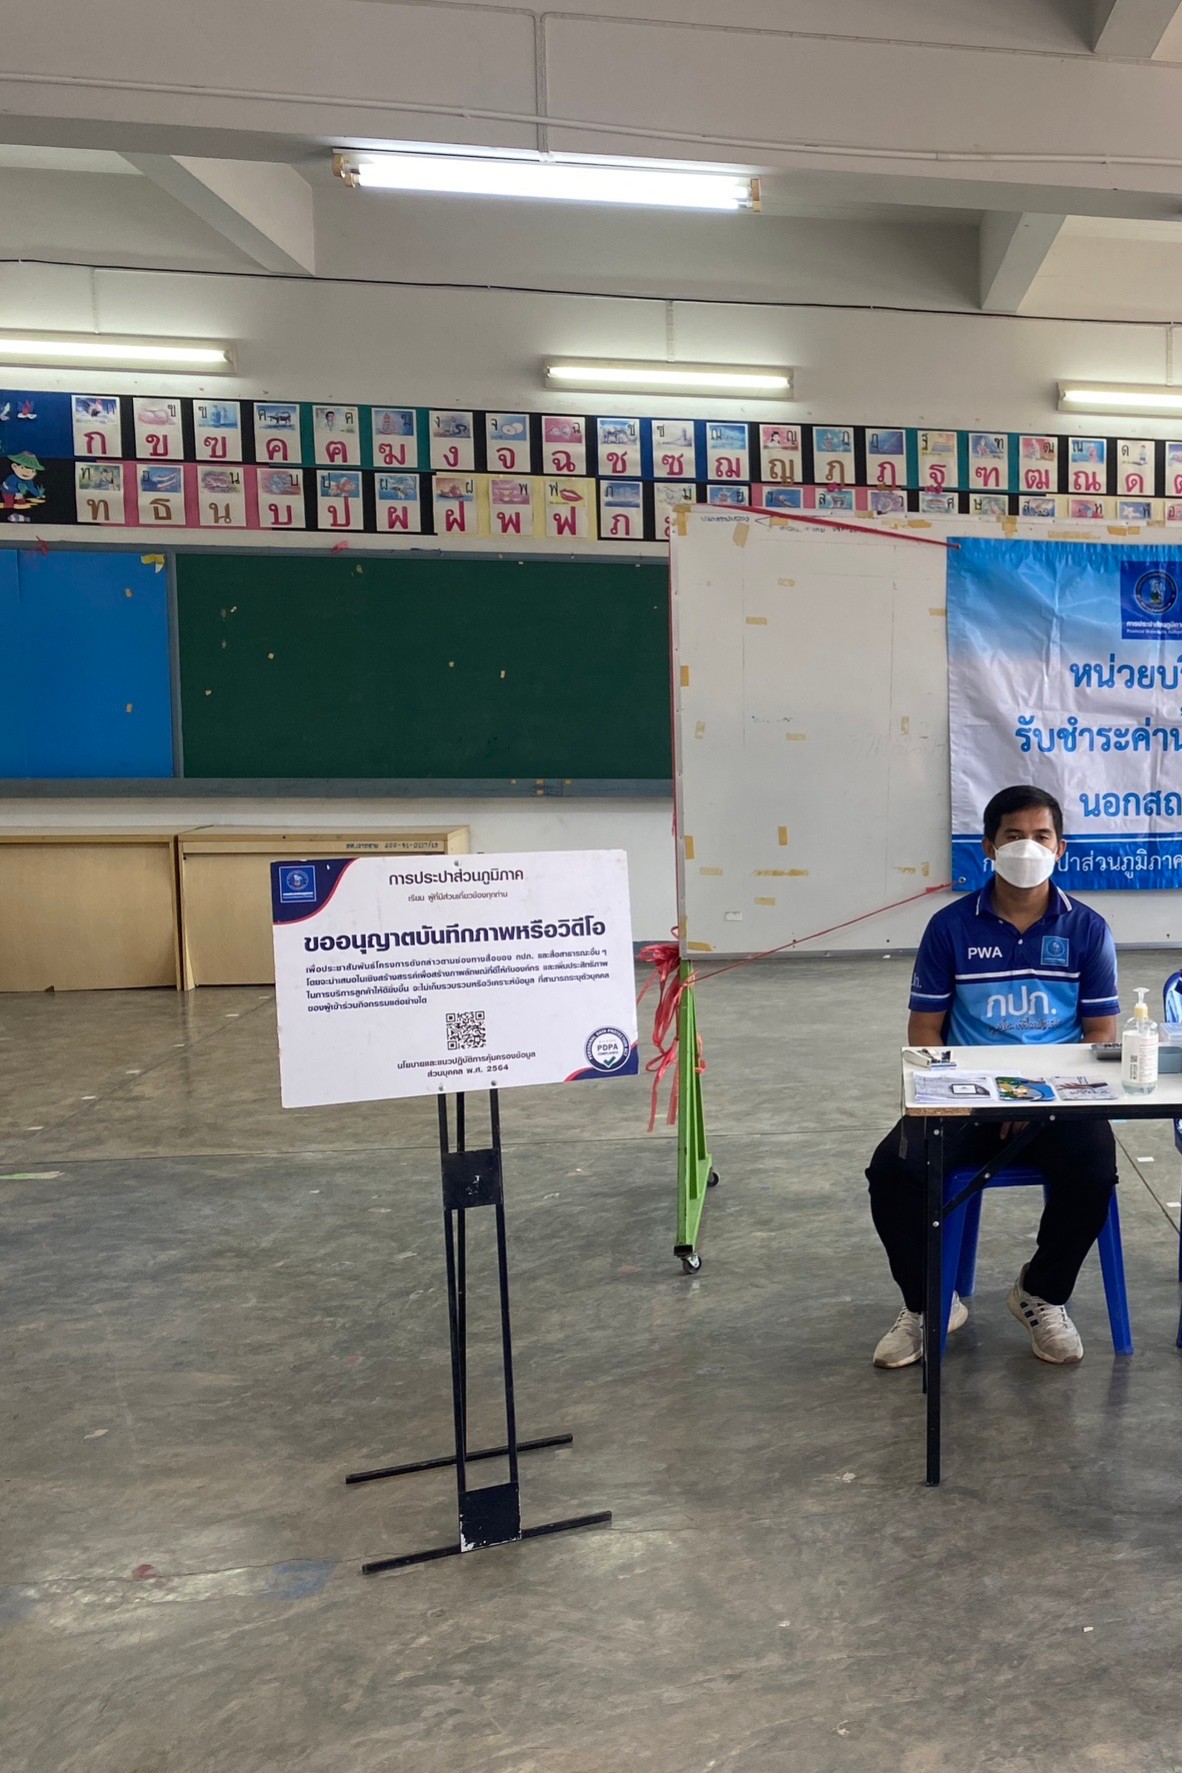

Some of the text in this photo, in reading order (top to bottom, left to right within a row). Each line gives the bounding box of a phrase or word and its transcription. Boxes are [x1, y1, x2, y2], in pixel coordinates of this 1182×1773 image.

[83, 431, 107, 454] ก
[145, 434, 168, 457] ข
[204, 436, 226, 458] ฃ
[266, 438, 288, 461] ค
[325, 441, 348, 463] ฅ
[379, 443, 405, 465] ฆ
[443, 446, 458, 467] ง
[496, 447, 515, 469] จ
[552, 450, 576, 472] ฉ
[607, 451, 628, 474] ช
[662, 453, 684, 476] ซ
[715, 457, 741, 478] ฌ
[768, 458, 794, 487] ญ
[925, 464, 947, 494] ฐ
[975, 466, 1000, 487] ฑ
[1025, 469, 1050, 490] ฒ
[1073, 470, 1101, 491] ณ
[1125, 473, 1144, 493] ด
[87, 496, 630, 536] ท ธ น บ ป ผ ฝ พ ฟ ภ
[389, 867, 524, 888] การประปาส่วนภูมิภาค
[304, 915, 606, 954] ขออนุญาตบันทึกภาพหรือวิดีโอ
[967, 945, 1003, 960] PWA
[597, 1043, 618, 1052] PDPA
[486, 1065, 509, 1073] 2564
